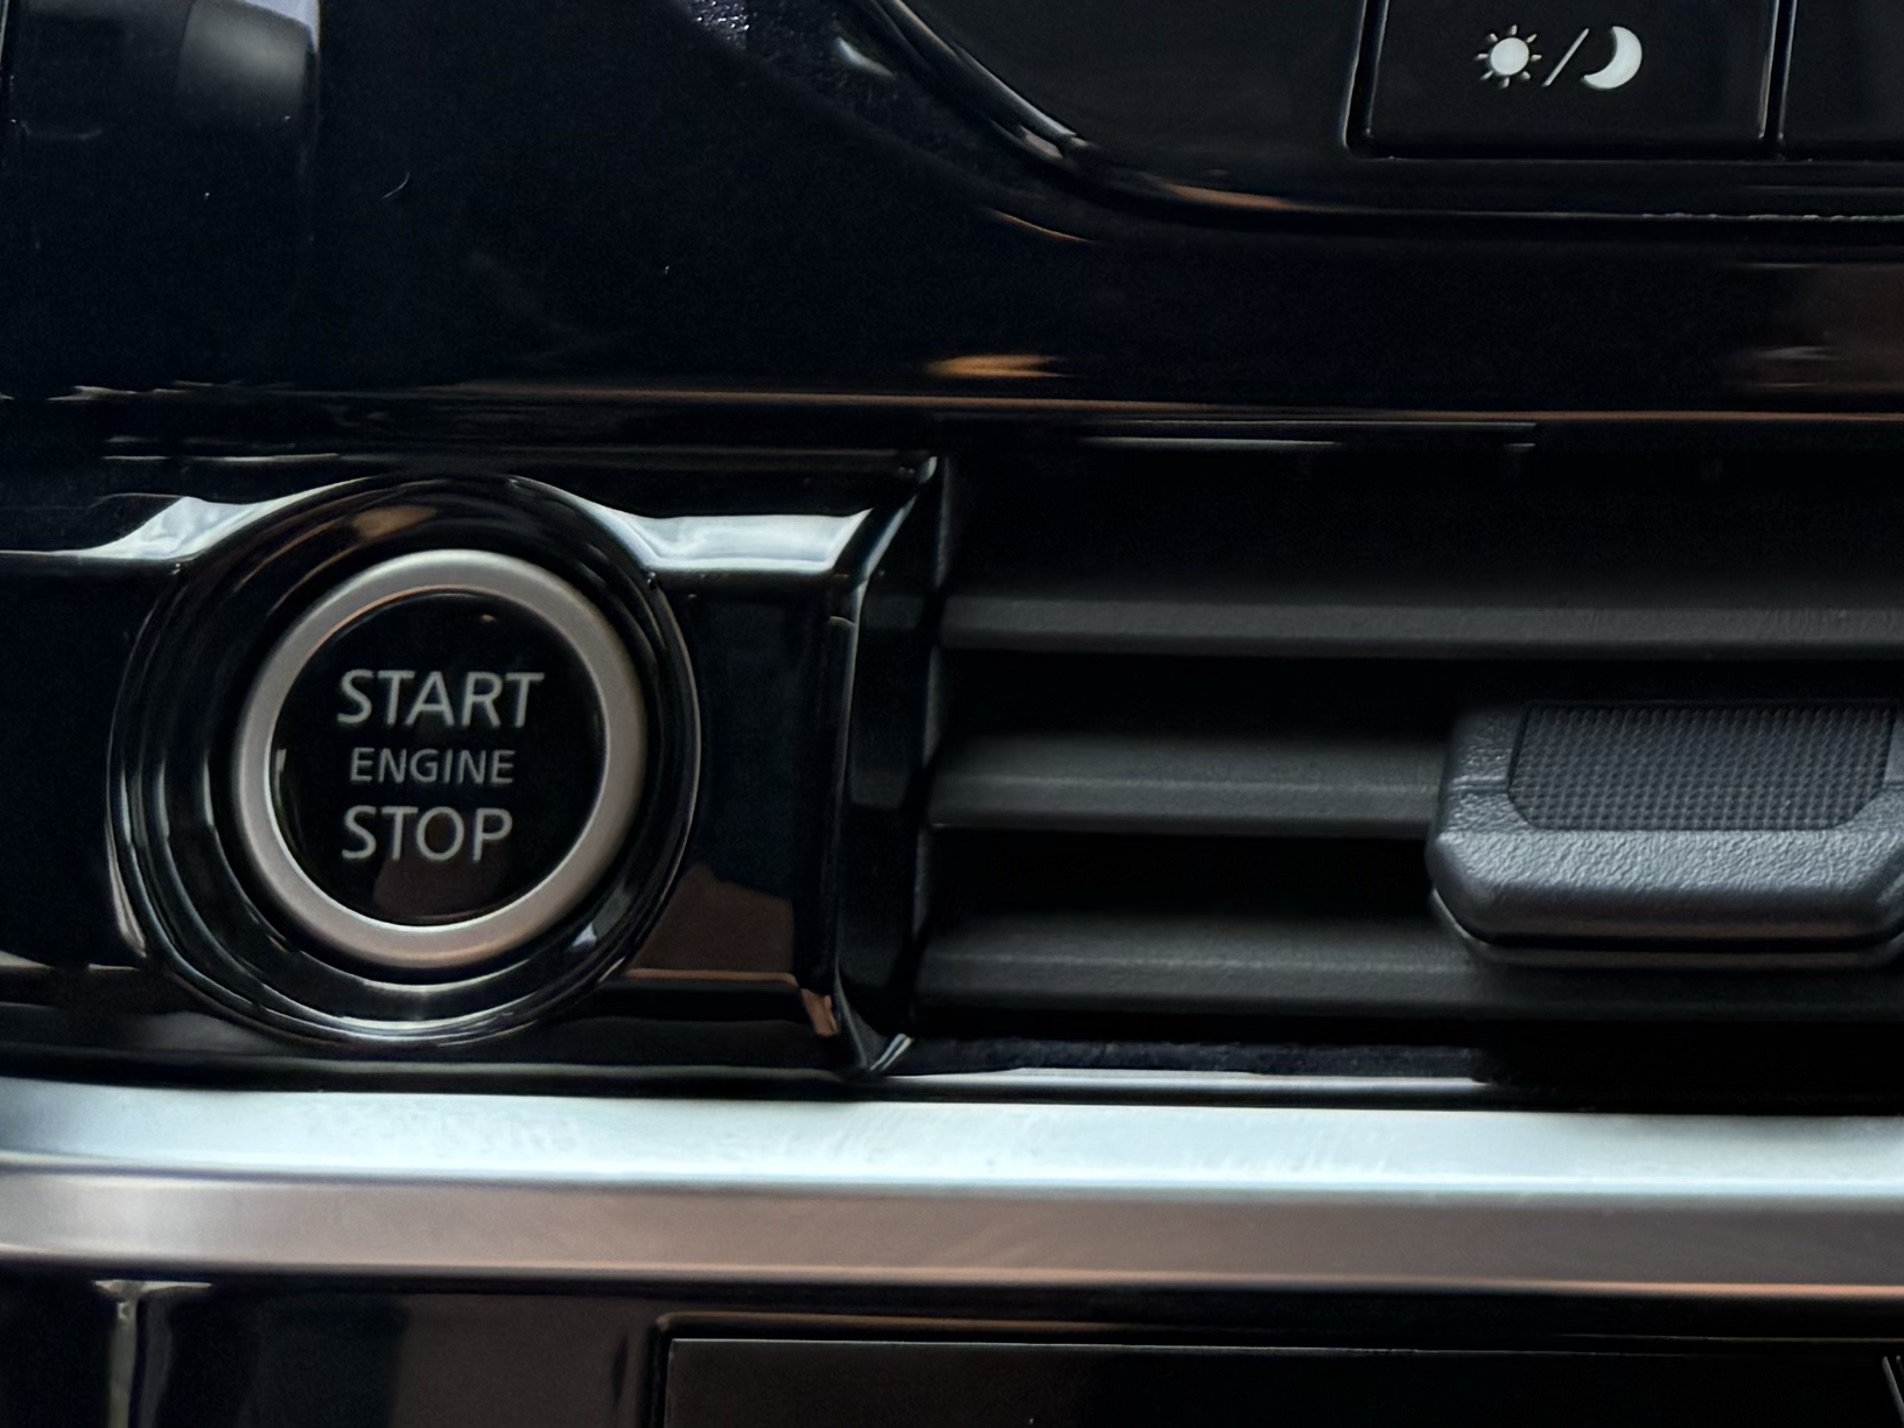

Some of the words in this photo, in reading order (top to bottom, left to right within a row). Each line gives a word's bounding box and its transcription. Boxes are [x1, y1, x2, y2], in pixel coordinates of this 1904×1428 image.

[338, 670, 543, 726] START
[351, 748, 514, 784] ENGINE
[343, 806, 512, 861] STOP
